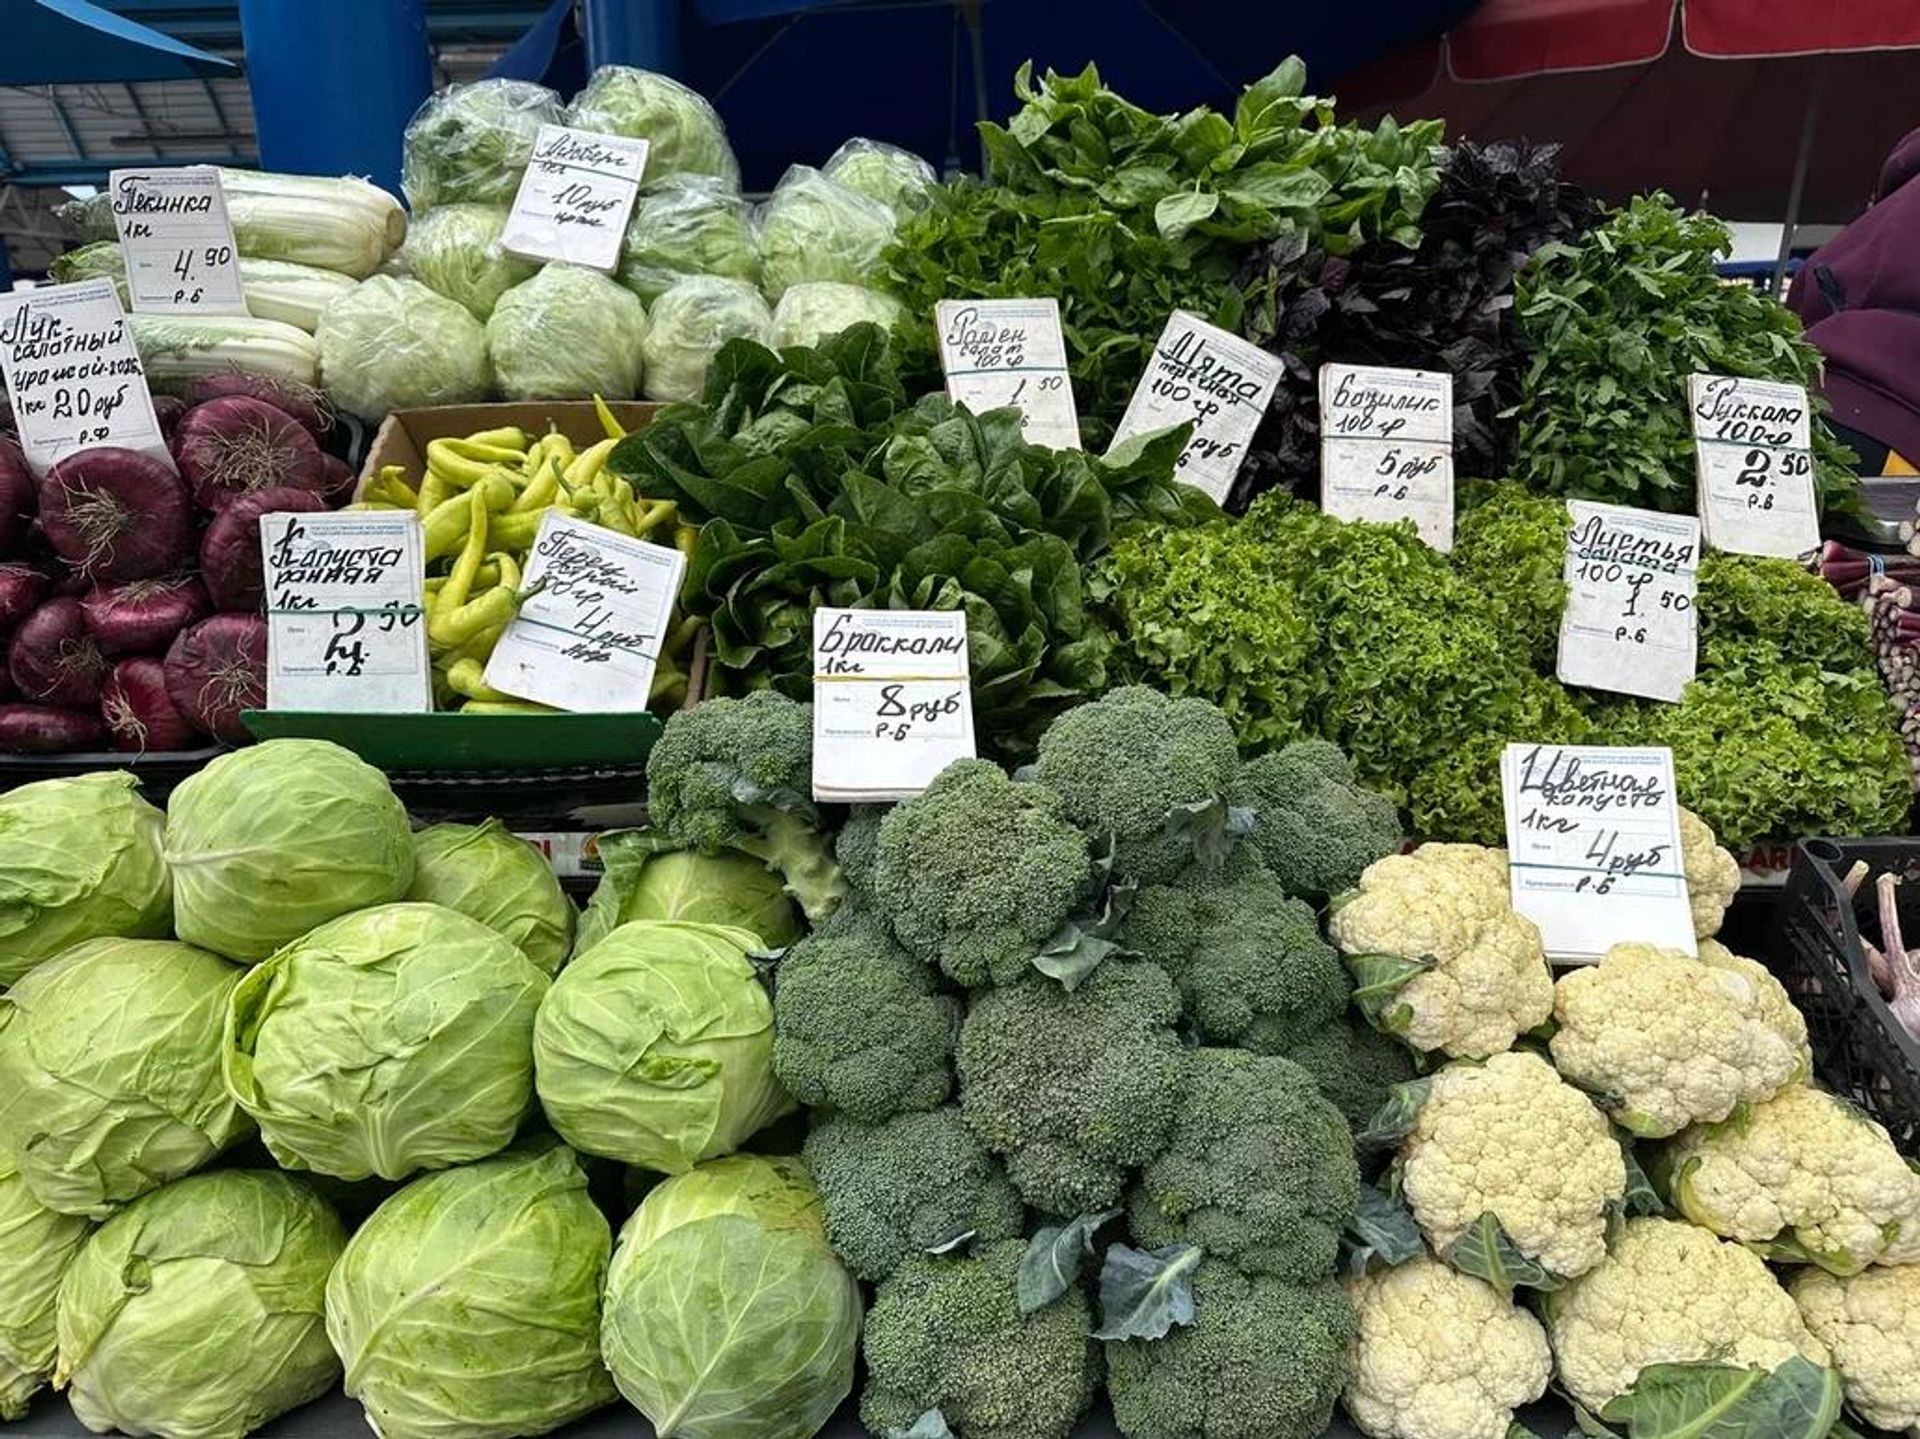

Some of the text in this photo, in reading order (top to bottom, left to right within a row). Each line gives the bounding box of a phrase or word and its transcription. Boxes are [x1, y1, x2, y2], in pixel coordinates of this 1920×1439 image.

[114, 176, 212, 214] Пекинка
[1333, 373, 1441, 417] Базилик
[269, 518, 403, 568] Капуста
[1570, 515, 1694, 563] Листья
[273, 567, 384, 590] ранняя
